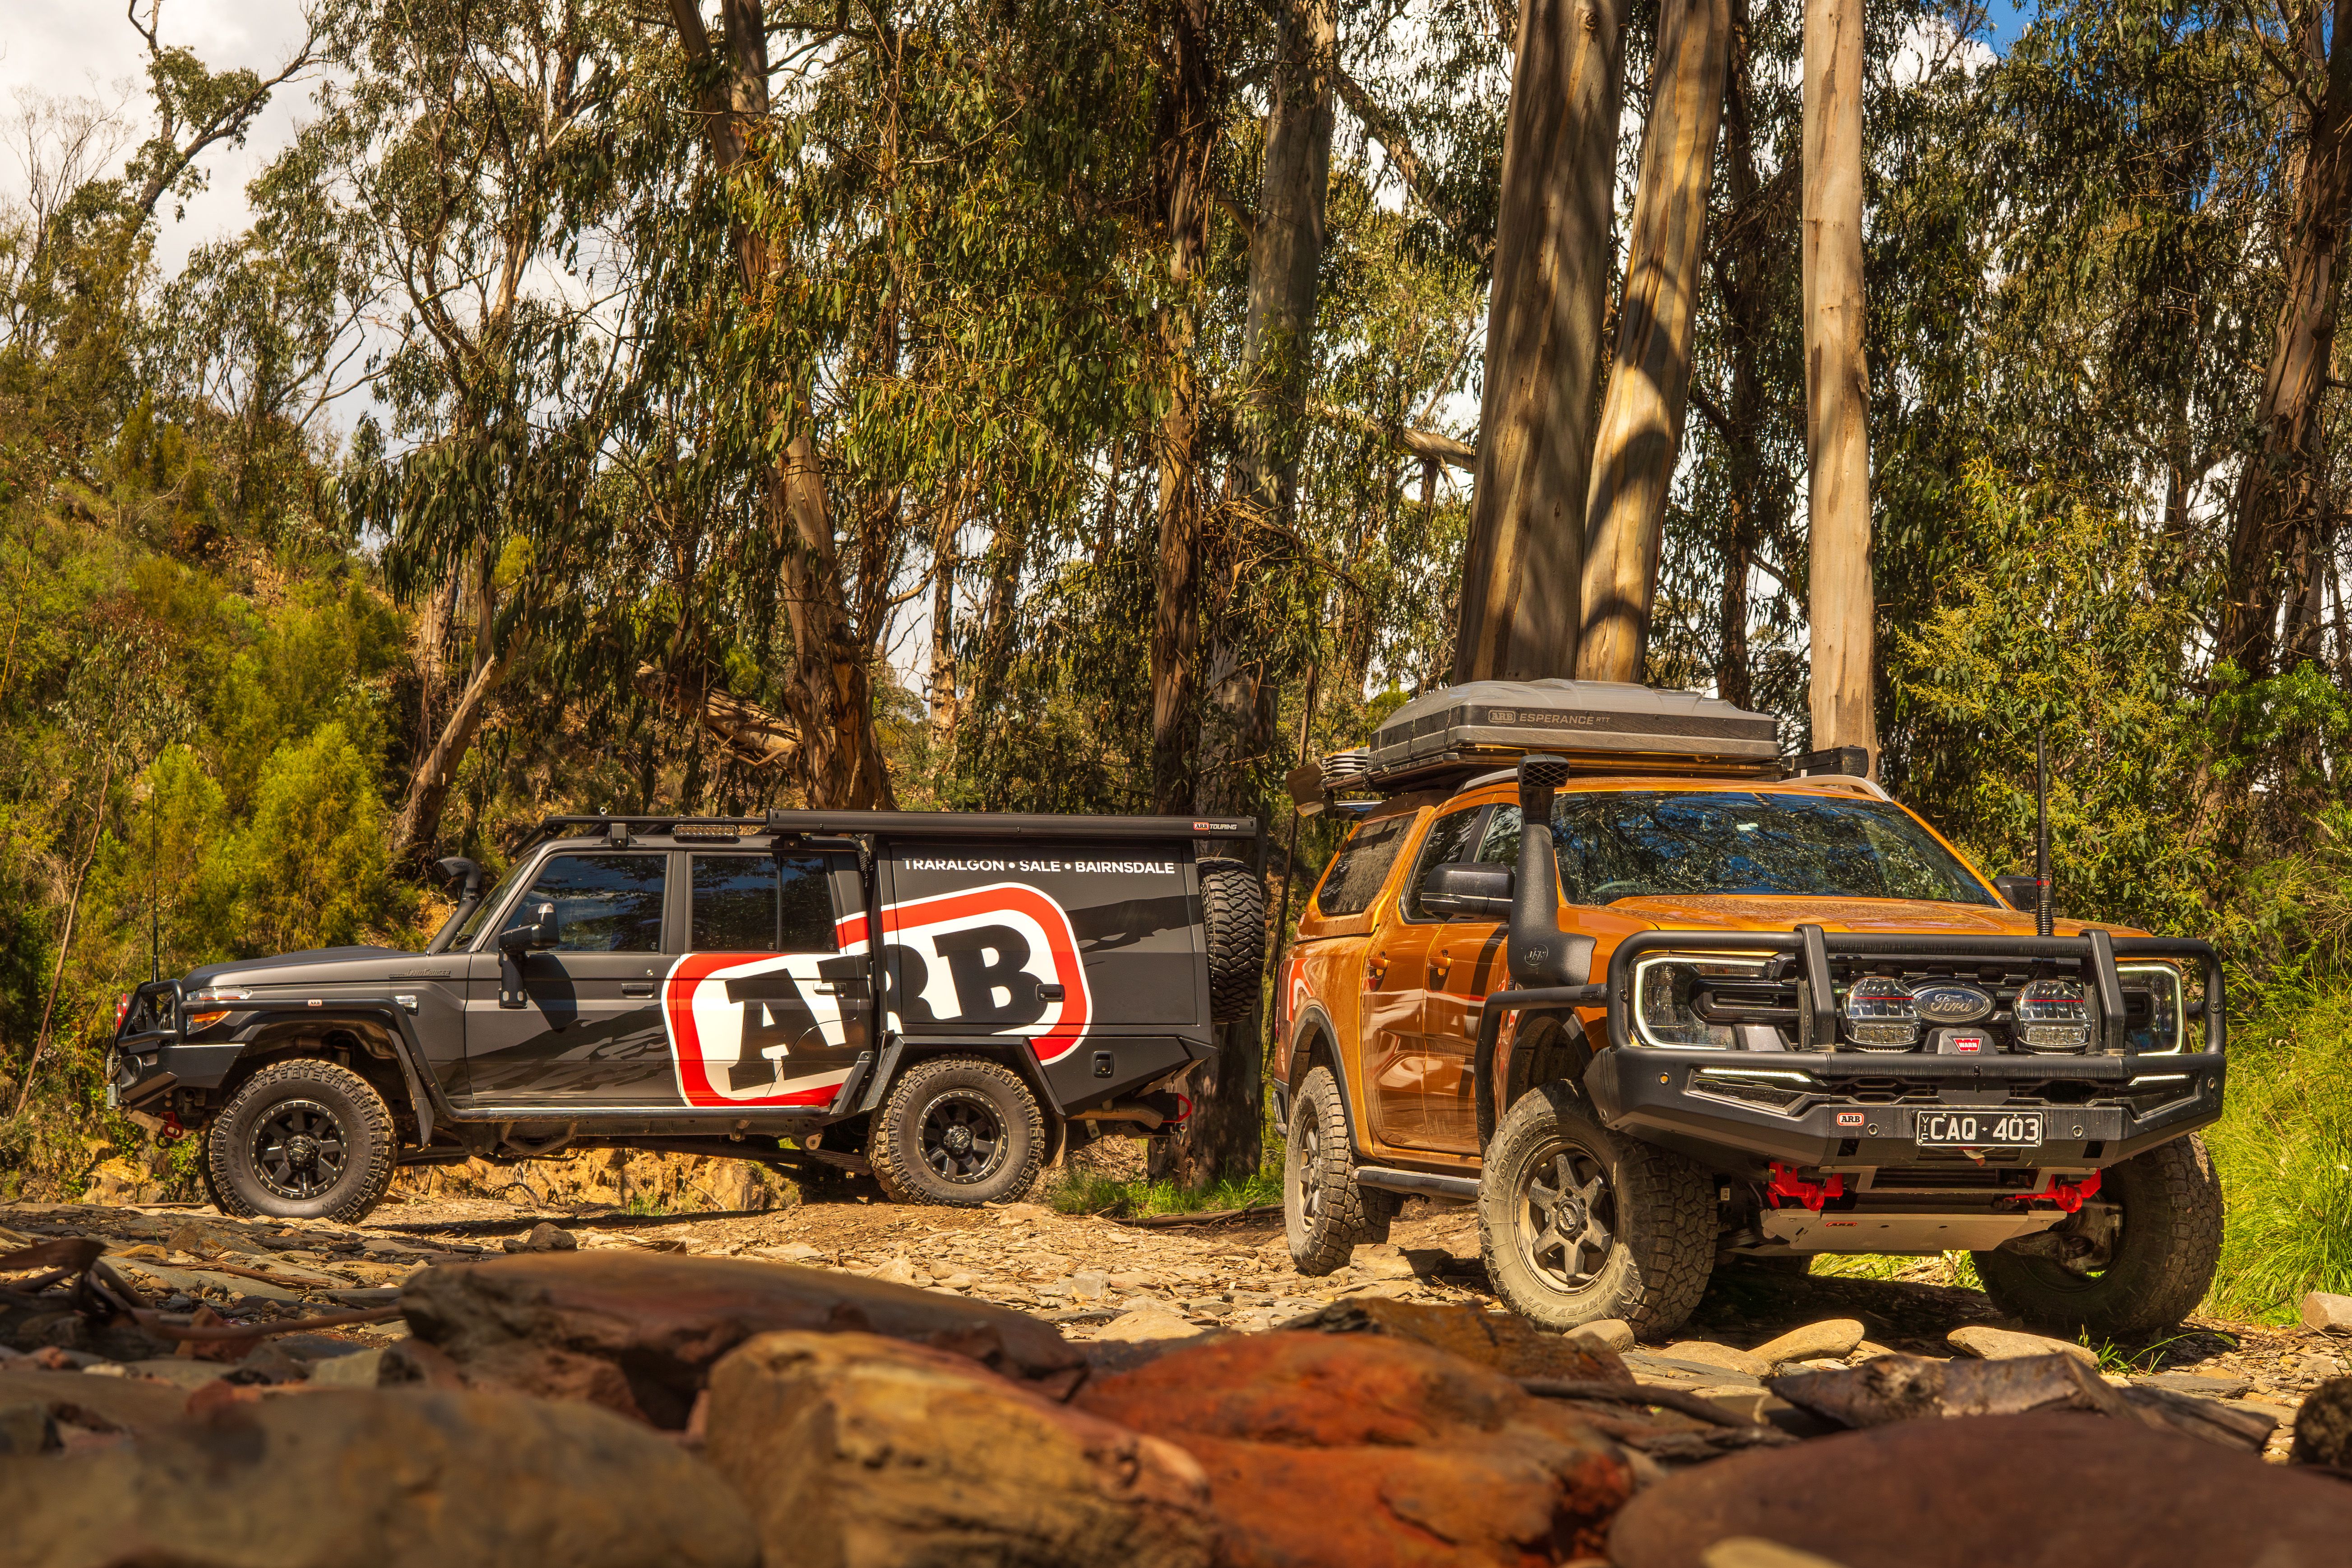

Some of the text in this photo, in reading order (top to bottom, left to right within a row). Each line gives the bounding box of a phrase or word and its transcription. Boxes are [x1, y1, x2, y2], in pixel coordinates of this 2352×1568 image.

[1491, 712, 1514, 721] ARB
[1519, 713, 1594, 725] ESPERANCE
[902, 858, 1175, 874] TRARALGON SALE BAIRNSDALE
[725, 924, 1048, 1091] ARB
[1931, 994, 1973, 1012] Ford
[1921, 1117, 1929, 1140] VIC
[1931, 1117, 2039, 1141] CAQ 403
[1495, 1136, 1521, 1191] TOYO
[1523, 1296, 1554, 1314] A/T
